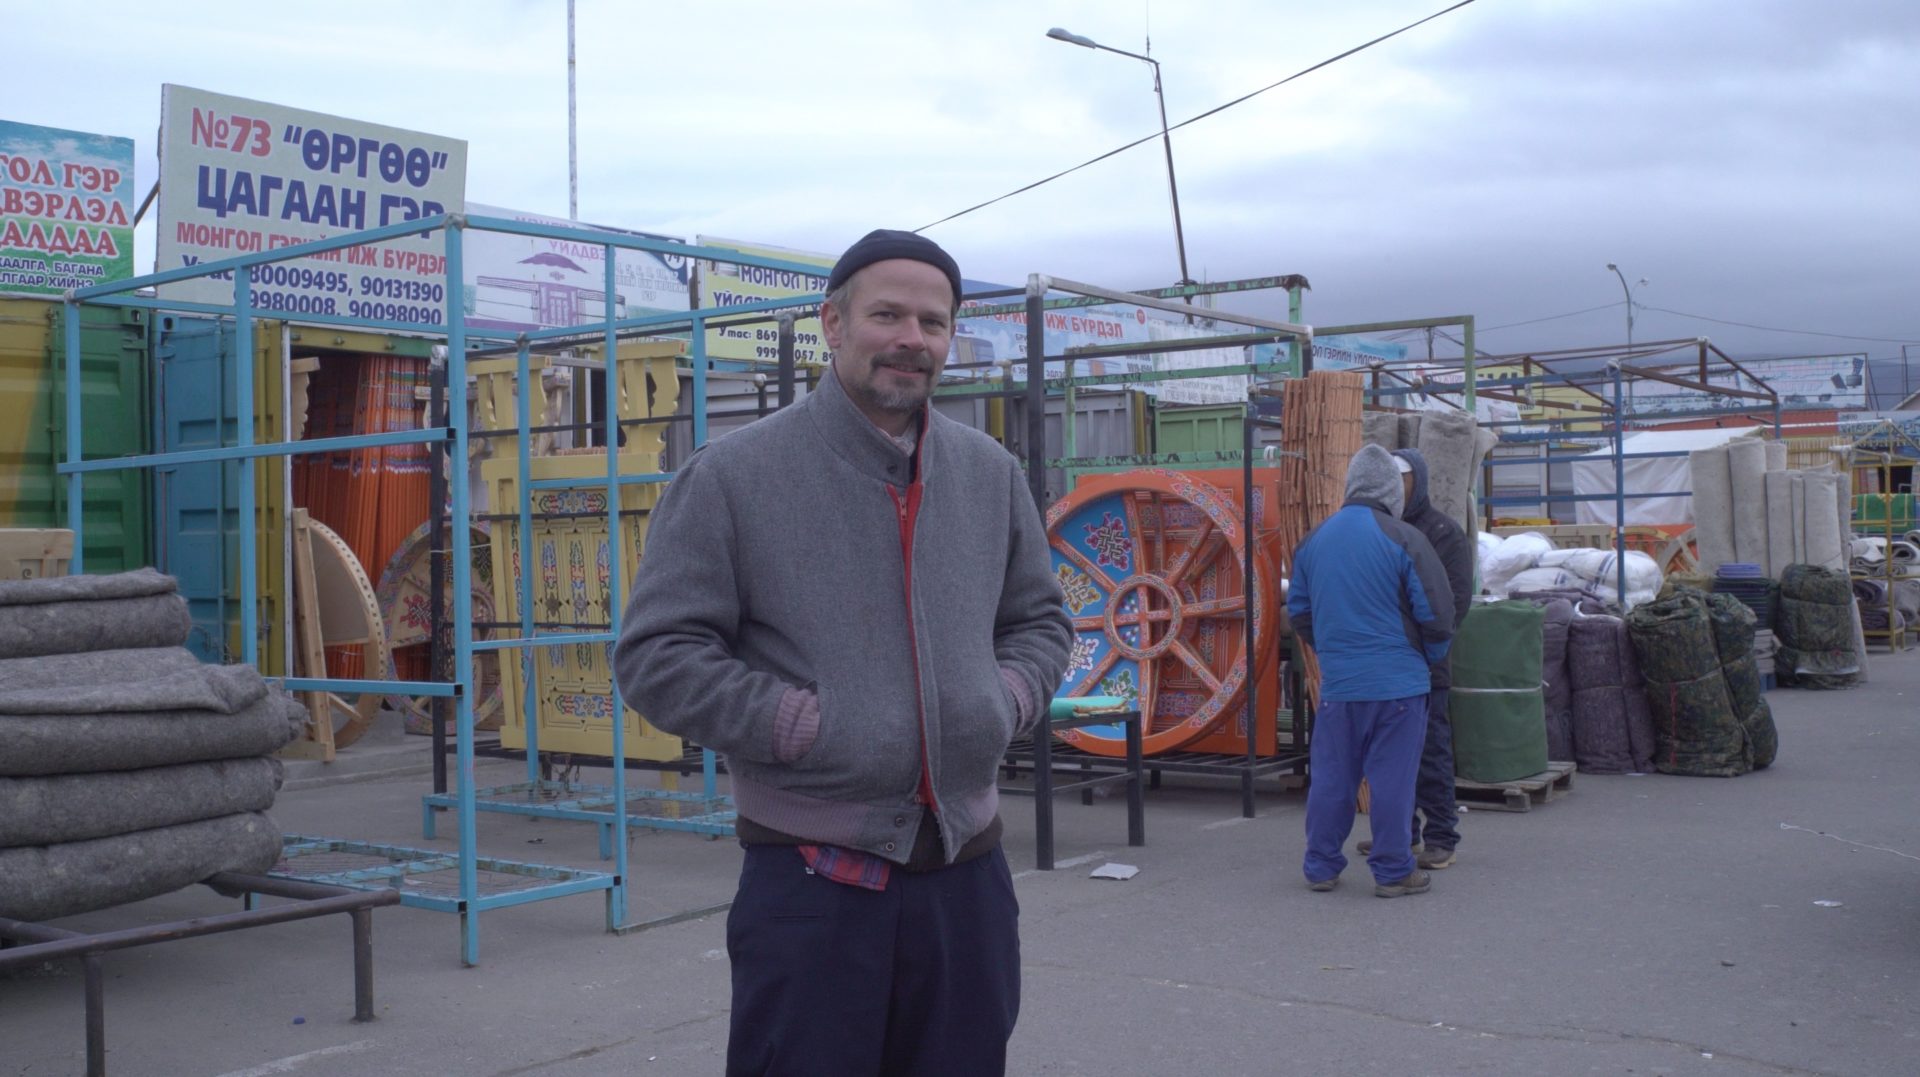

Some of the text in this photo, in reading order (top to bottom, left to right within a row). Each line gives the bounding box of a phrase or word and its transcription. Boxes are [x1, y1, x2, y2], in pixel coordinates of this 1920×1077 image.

[64, 163, 120, 193] ГЭР
[0, 187, 128, 226] ВЭРЛЭЛ
[197, 164, 366, 230] ЦАГААН
[176, 221, 262, 252] МОНГОЛ
[347, 245, 377, 267] ИЖ
[0, 272, 44, 287] ЛГААР
[54, 262, 104, 276] БАГАНА
[360, 275, 443, 303] 90131390
[348, 299, 442, 325] 90098090
[1044, 311, 1068, 330] ИЖ
